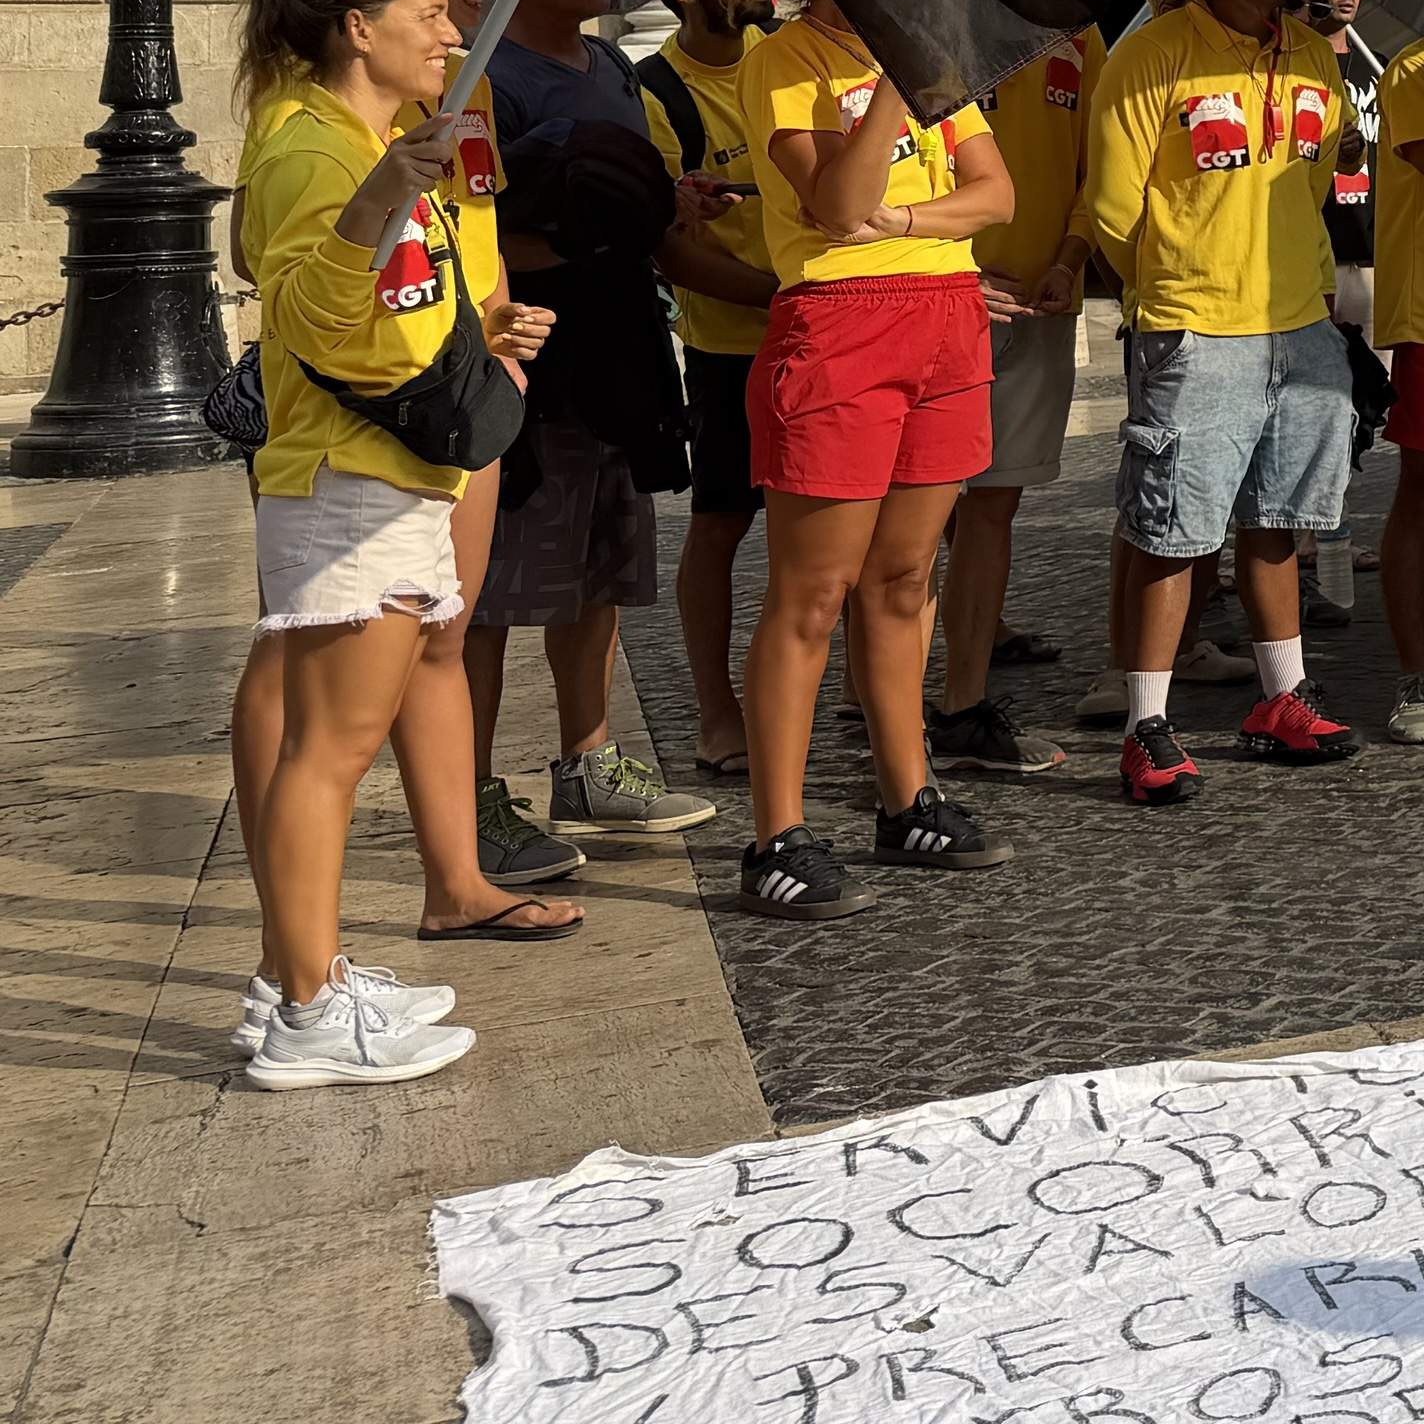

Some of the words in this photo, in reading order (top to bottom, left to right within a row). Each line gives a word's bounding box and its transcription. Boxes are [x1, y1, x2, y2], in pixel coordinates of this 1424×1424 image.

[1046, 85, 1077, 108] CGT
[1196, 148, 1247, 169] CGT
[1297, 139, 1319, 159] CGT
[1336, 191, 1369, 205] CGT
[381, 278, 438, 311] CGT
